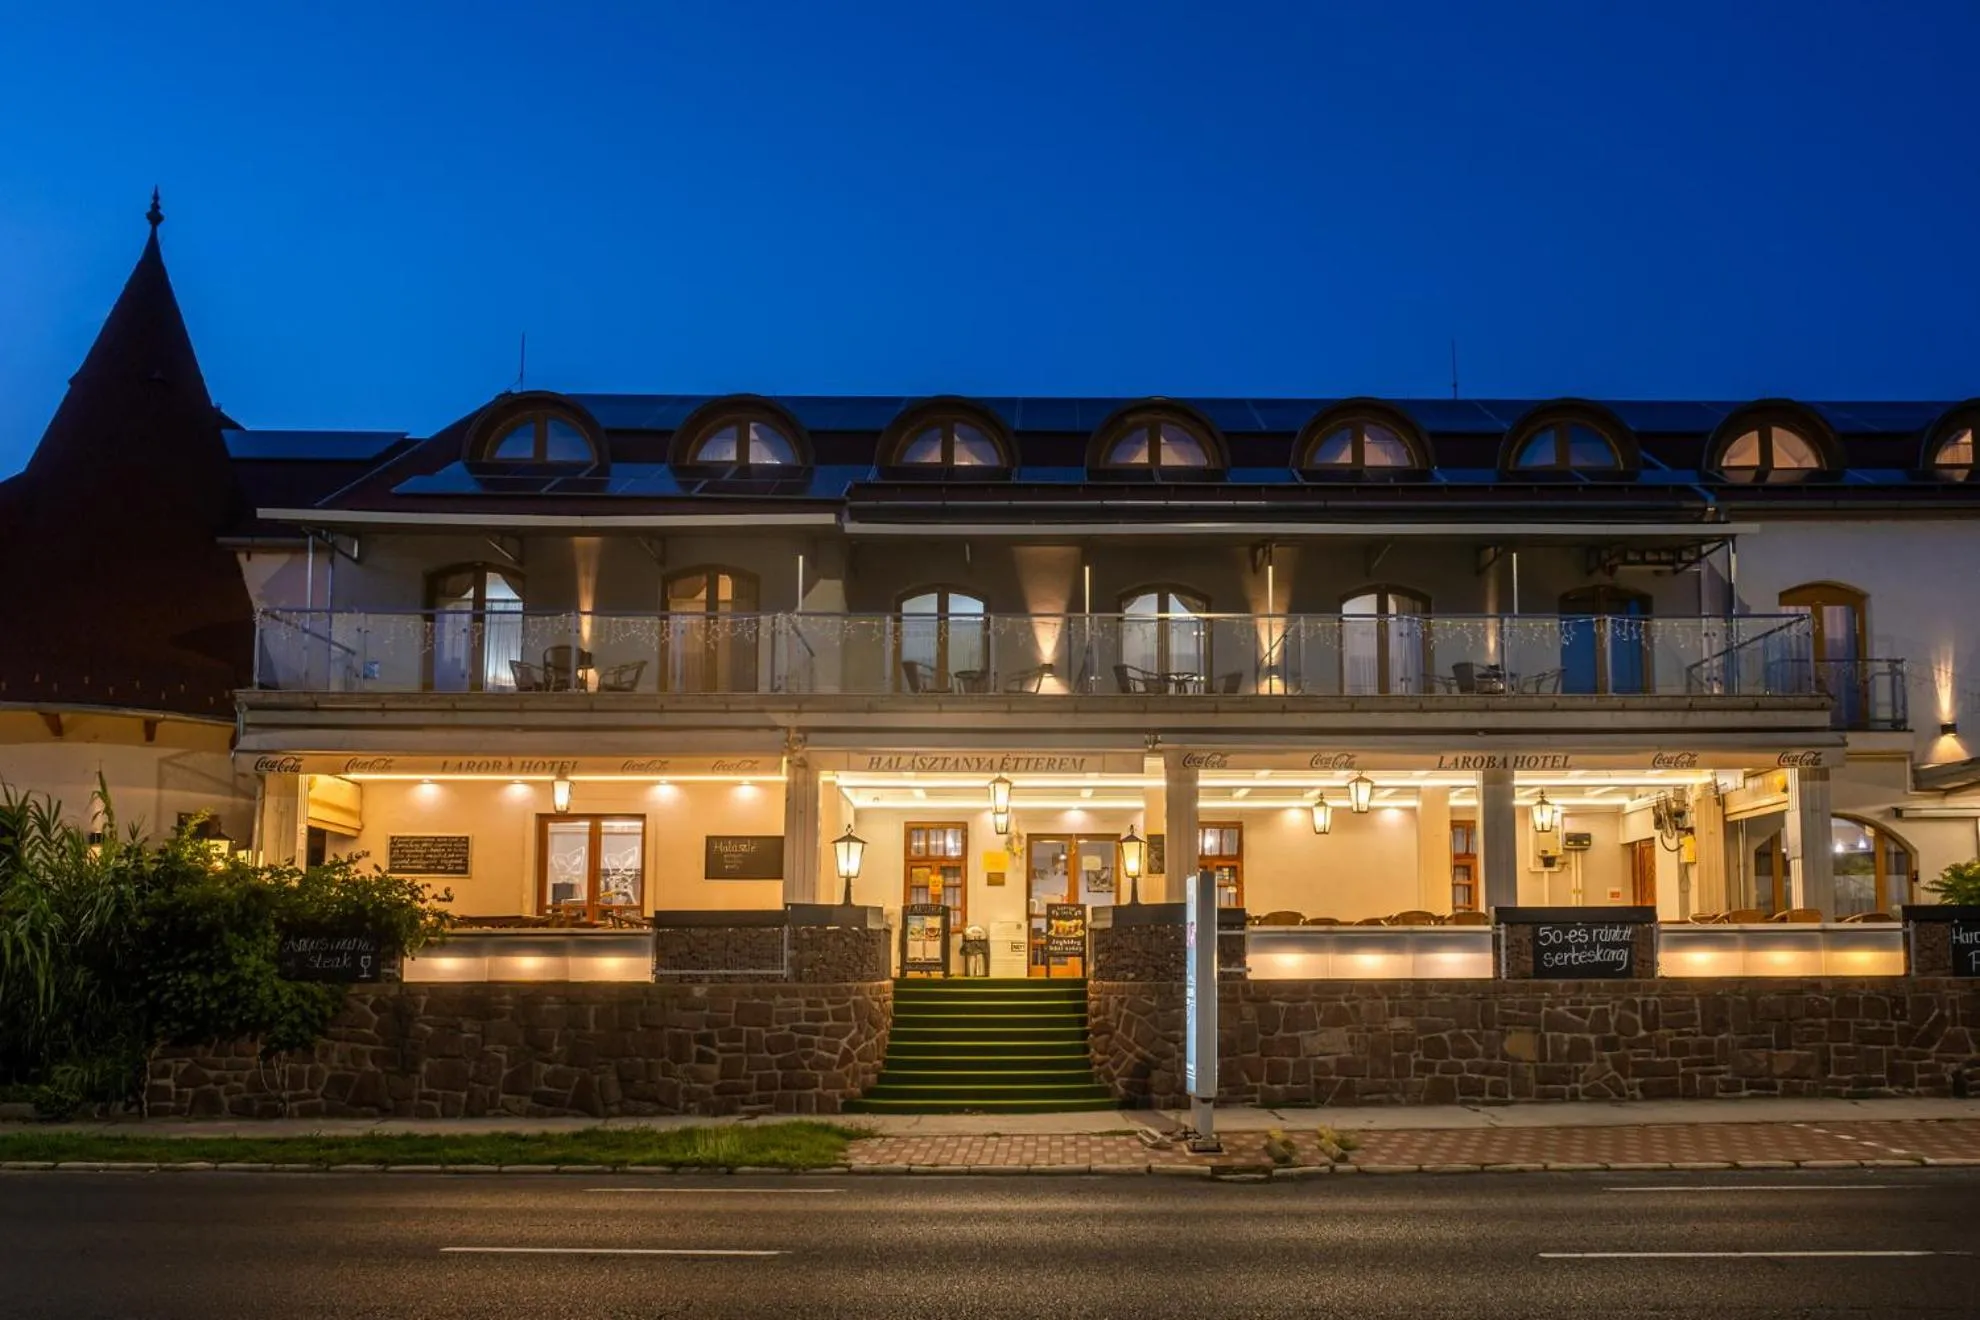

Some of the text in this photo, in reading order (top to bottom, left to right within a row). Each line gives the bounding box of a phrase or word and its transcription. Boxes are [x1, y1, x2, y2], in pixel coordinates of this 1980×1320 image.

[868, 753, 1086, 771] HALÁSZTANYA ÉTTEREM
[1438, 755, 1572, 769] LAROBA HOTEL
[1539, 926, 1589, 946] 50-es
